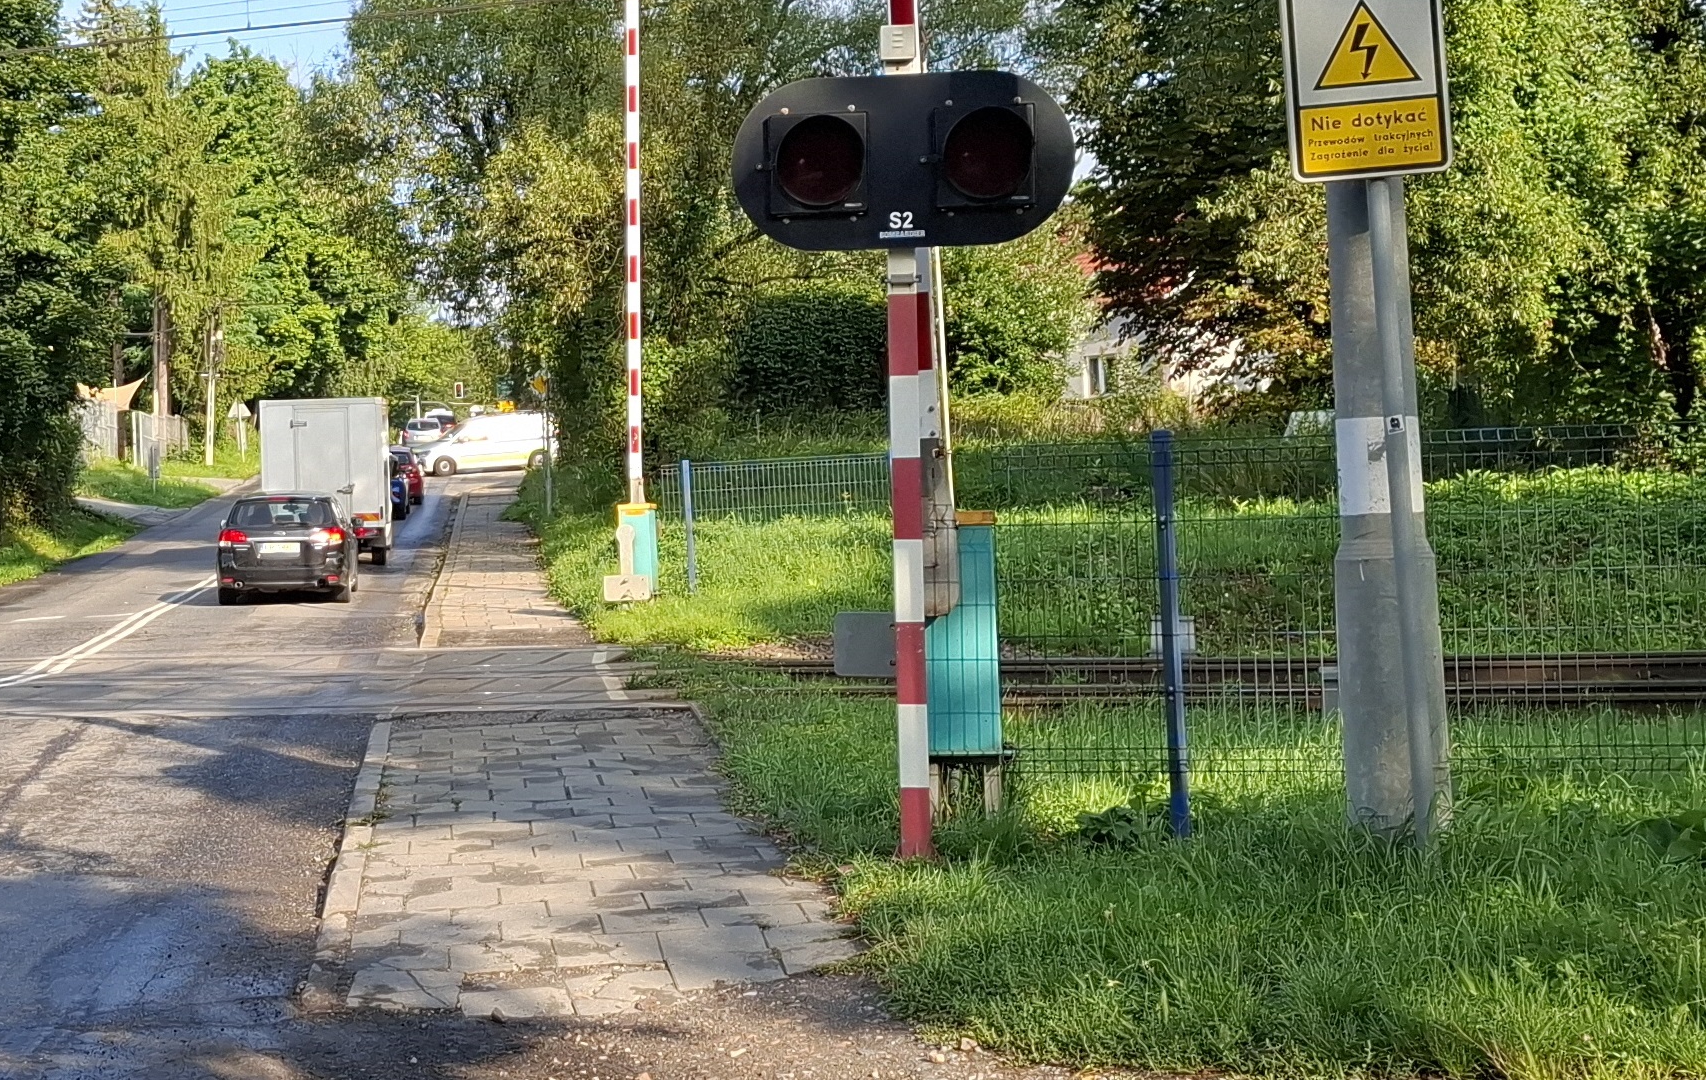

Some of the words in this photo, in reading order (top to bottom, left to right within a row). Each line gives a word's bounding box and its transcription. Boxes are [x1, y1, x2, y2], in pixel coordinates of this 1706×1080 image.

[1311, 116, 1341, 131] Nie
[1352, 107, 1427, 129] dotykać
[1308, 135, 1365, 147] Przewodów
[1374, 129, 1434, 142] trakcyjnych
[1310, 148, 1369, 161] Zagrożenie
[1377, 146, 1395, 155] dla
[1403, 142, 1434, 155] życia!
[889, 211, 914, 229] S2
